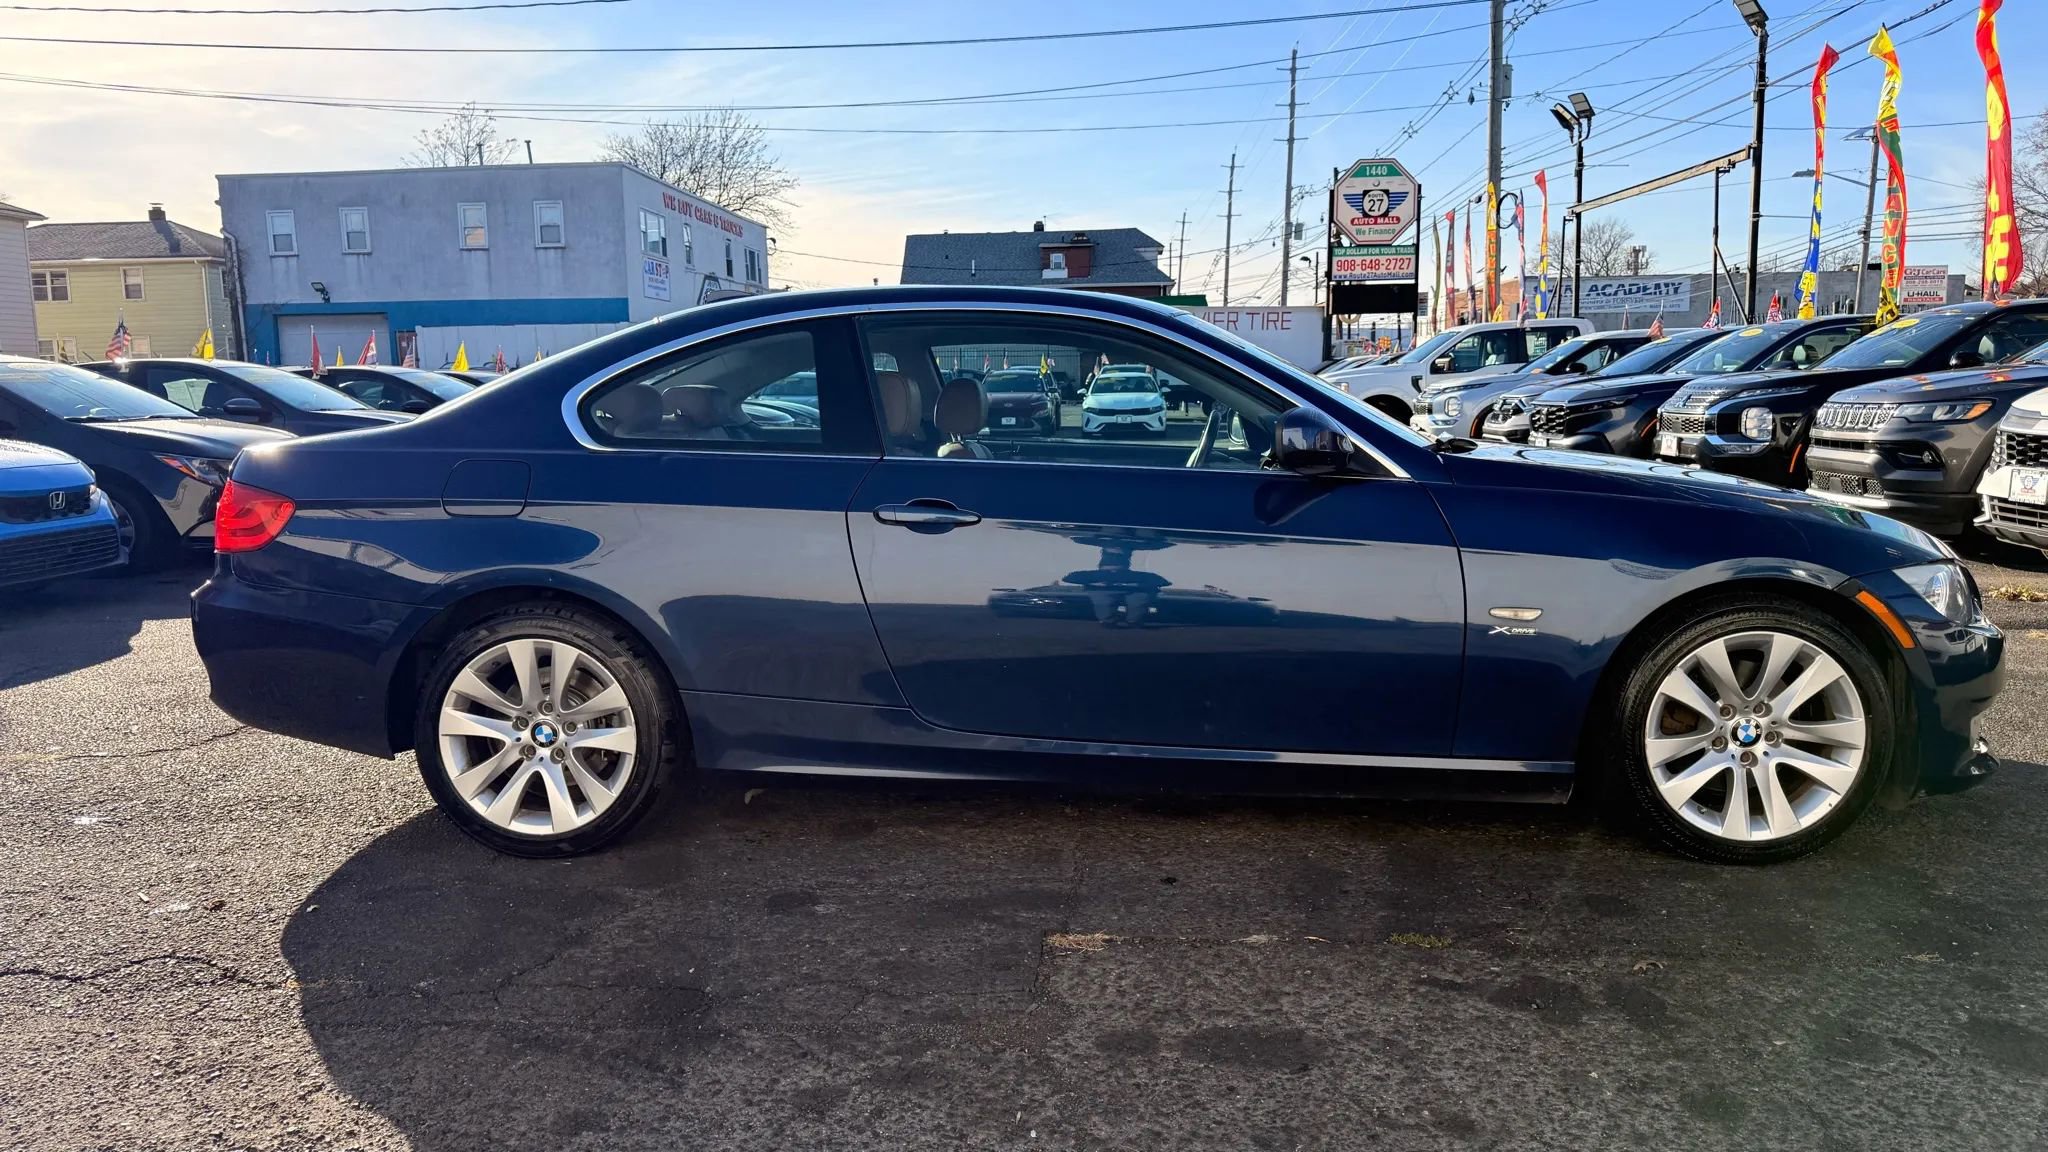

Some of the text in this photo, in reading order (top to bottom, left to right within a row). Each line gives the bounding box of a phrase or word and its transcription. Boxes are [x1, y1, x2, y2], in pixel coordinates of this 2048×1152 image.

[1365, 165, 1388, 176] 1440
[662, 191, 676, 211] WE
[677, 198, 693, 217] BUY
[694, 205, 713, 225] CARS
[1367, 199, 1384, 213] 27
[1353, 216, 1399, 225] AUTO MALL
[1355, 227, 1397, 236] We Finance
[1336, 257, 1412, 272] 908-648-2727
[1333, 271, 1415, 280] www.Route27AutoMall.com
[1586, 282, 1684, 297] ACADEMY
[1245, 311, 1293, 331] TIRE
